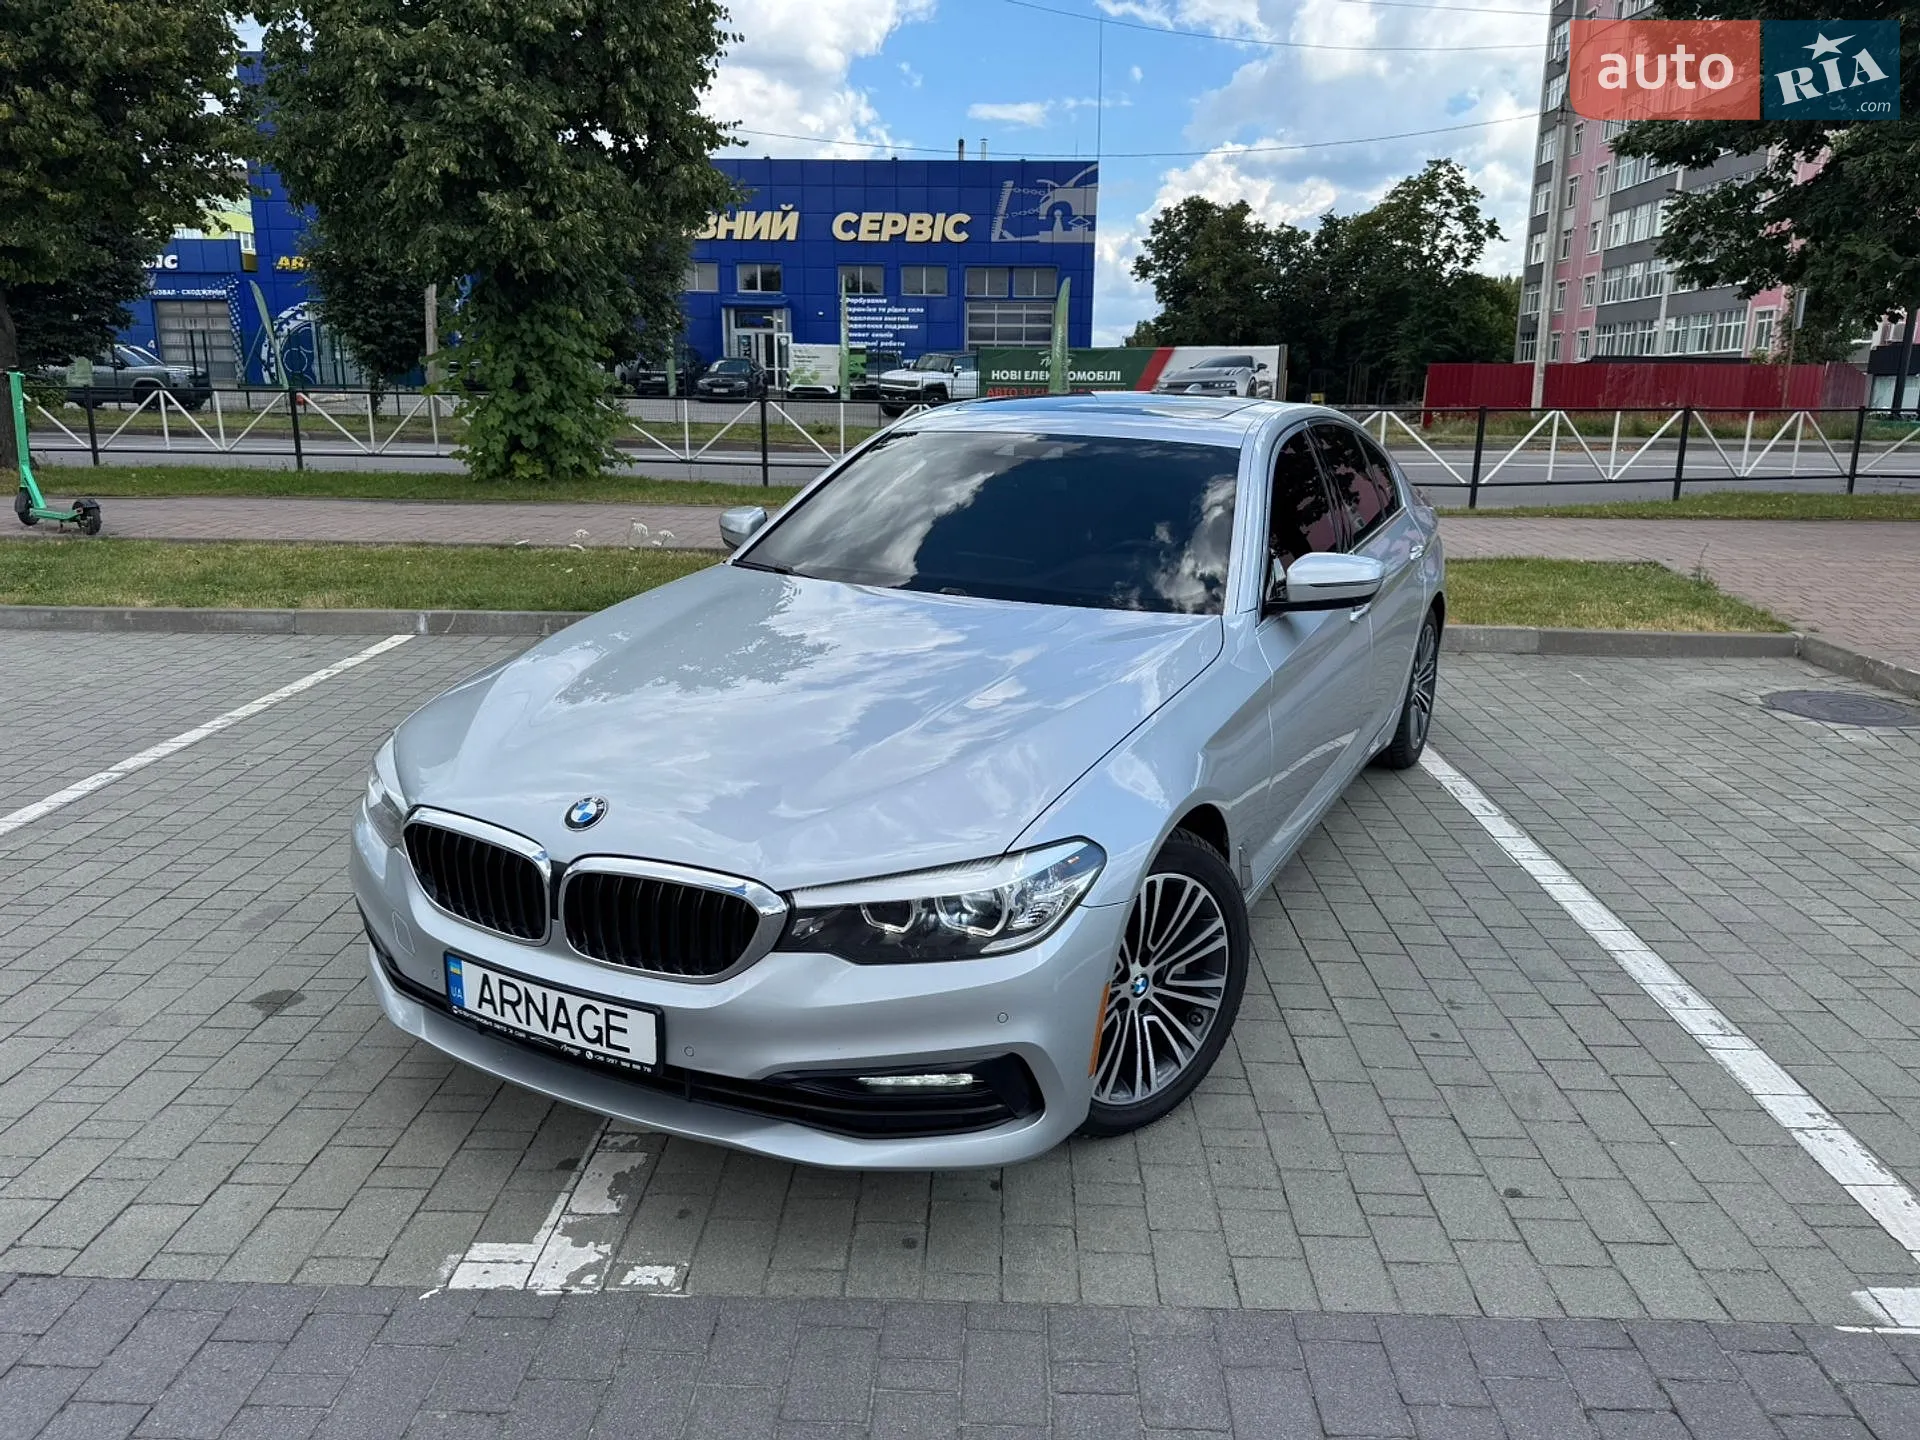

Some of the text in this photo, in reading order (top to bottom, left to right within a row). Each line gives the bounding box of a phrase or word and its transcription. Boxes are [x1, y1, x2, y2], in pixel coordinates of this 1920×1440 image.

[693, 204, 972, 243] ВНИЙ СЕРВІС
[991, 370, 1122, 382] НОВІ ЕЛЕОМОБІЛІ
[450, 985, 463, 1000] UA
[477, 973, 631, 1054] ARNAGE
